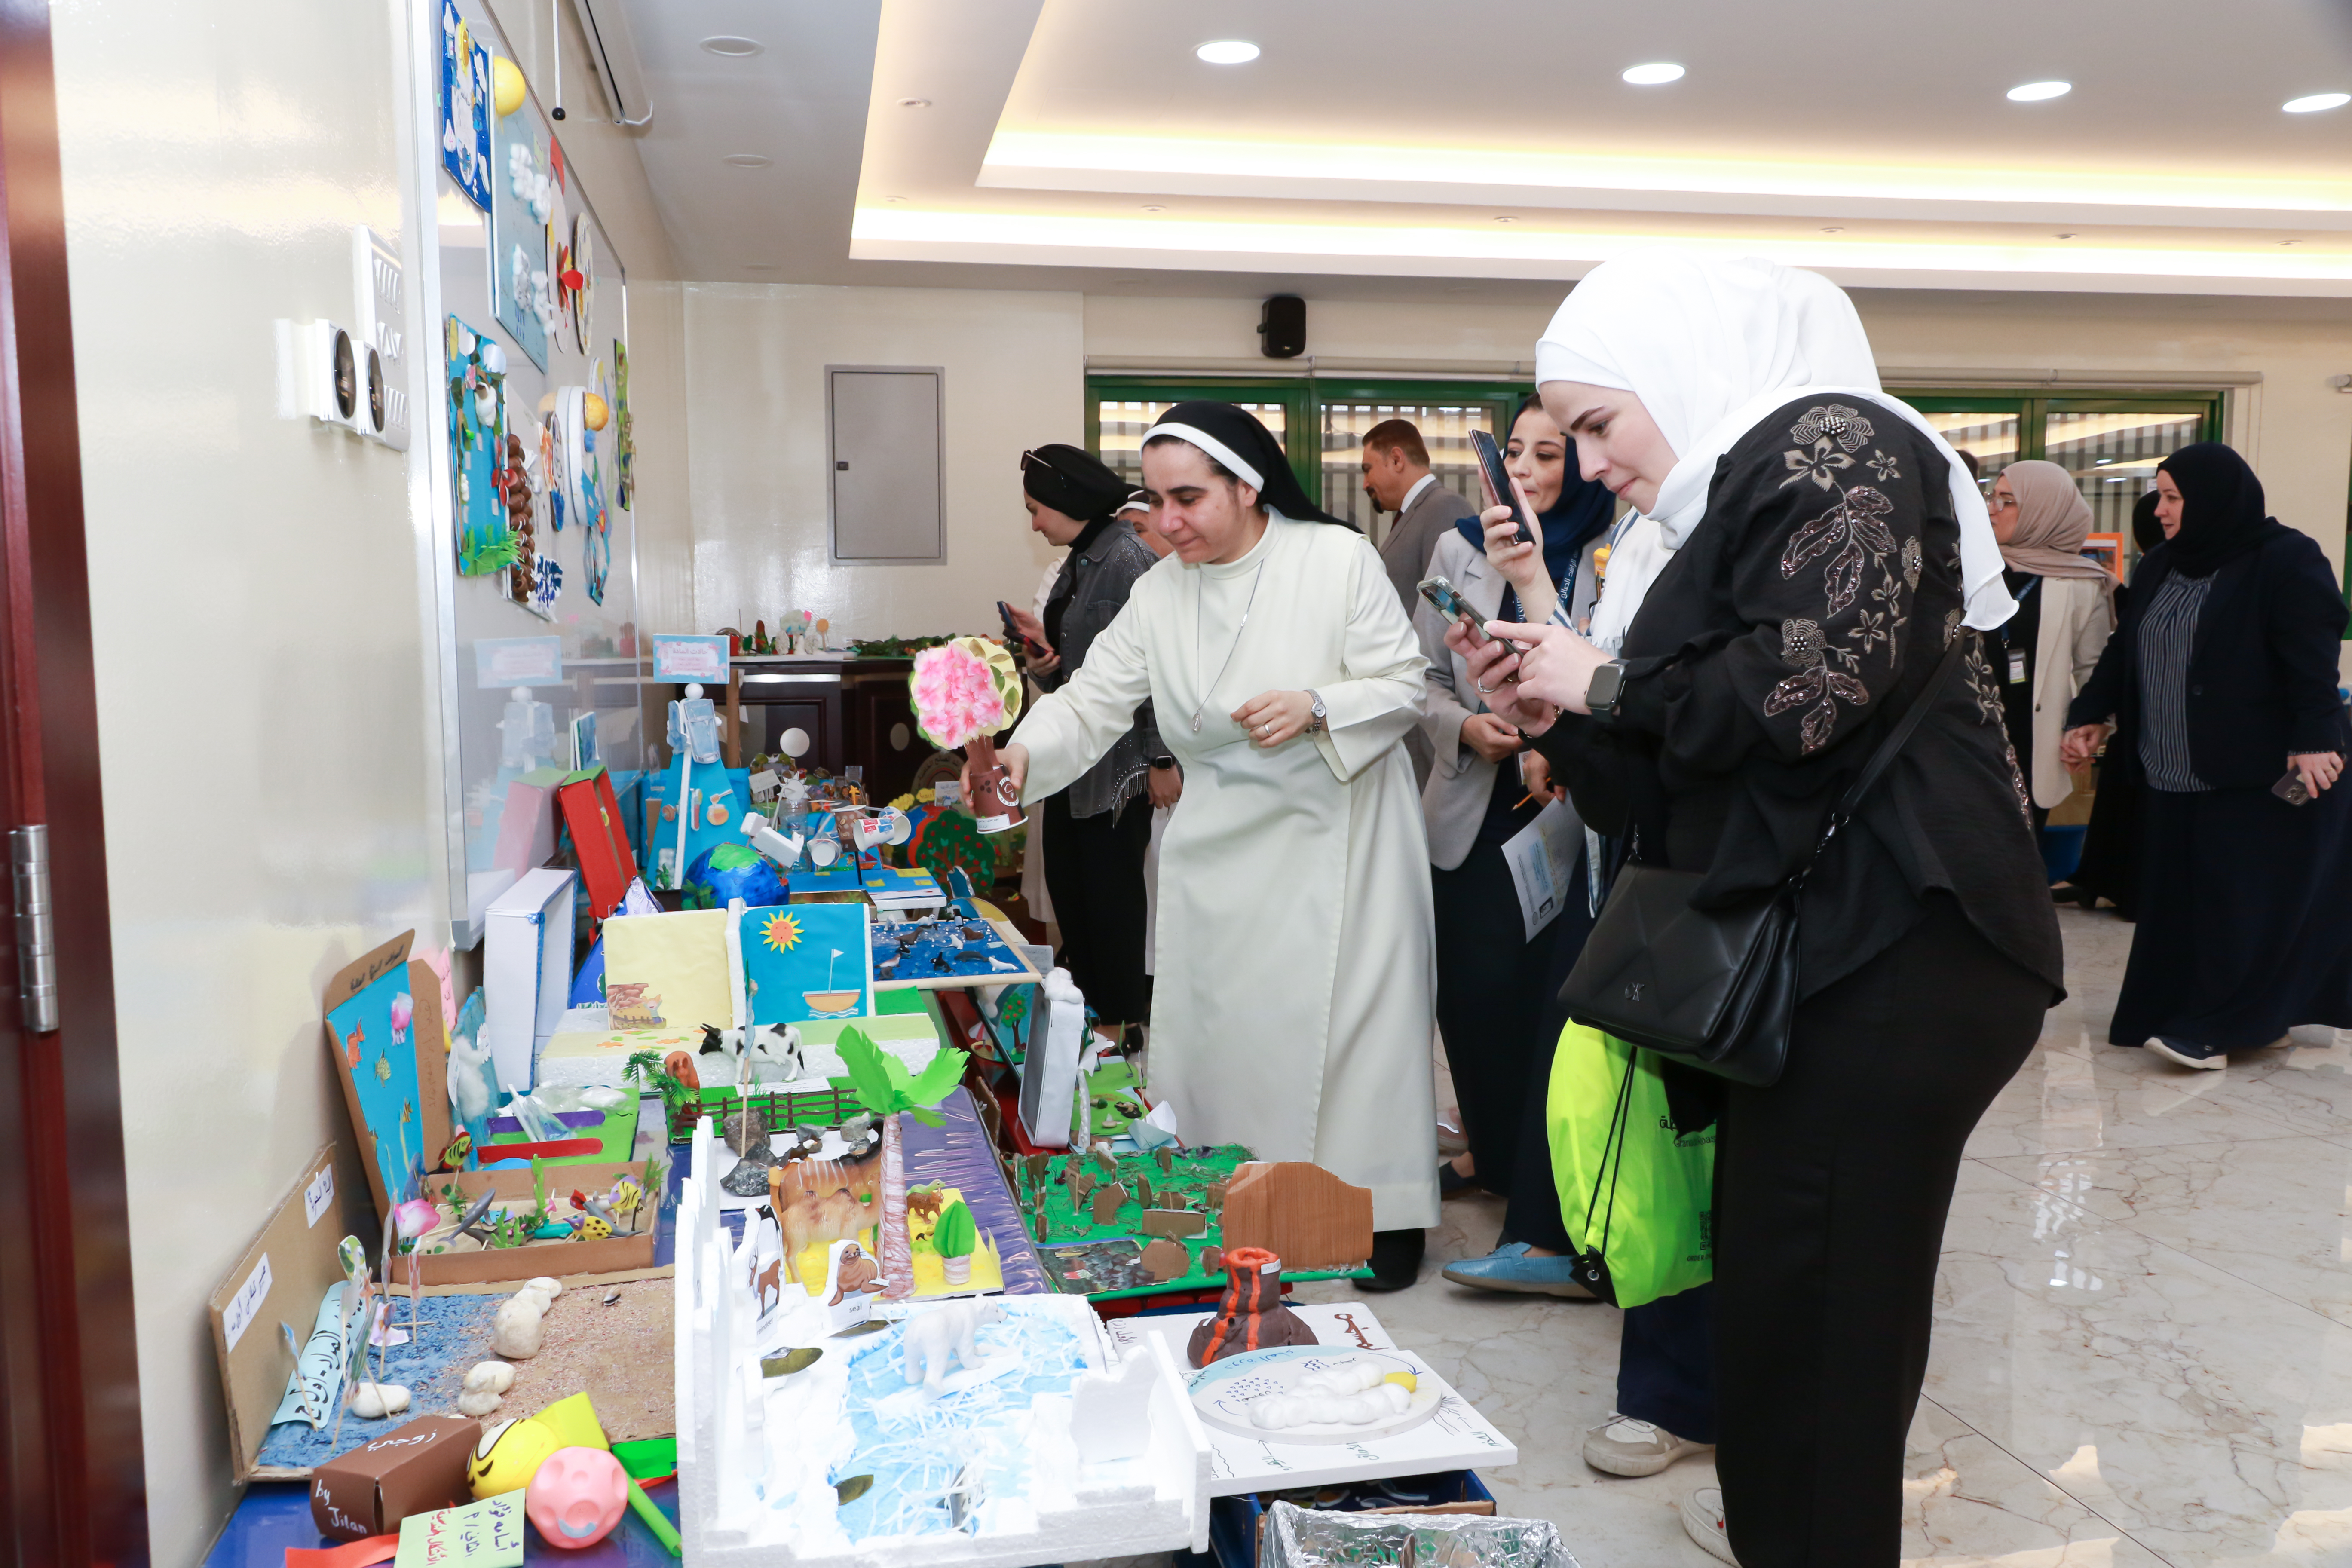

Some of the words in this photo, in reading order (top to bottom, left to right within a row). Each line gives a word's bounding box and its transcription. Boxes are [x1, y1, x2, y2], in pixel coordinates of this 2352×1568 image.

[1560, 578, 1571, 599] الصالح
[1625, 982, 1644, 1001] CK
[849, 1303, 862, 1313] seal
[757, 1317, 773, 1335] reindeer
[1225, 1358, 1256, 1369] دورة
[1259, 1349, 1293, 1362] الماء
[368, 1429, 437, 1452] زوجي
[315, 1479, 330, 1506] by
[328, 1507, 367, 1534] Jilan
